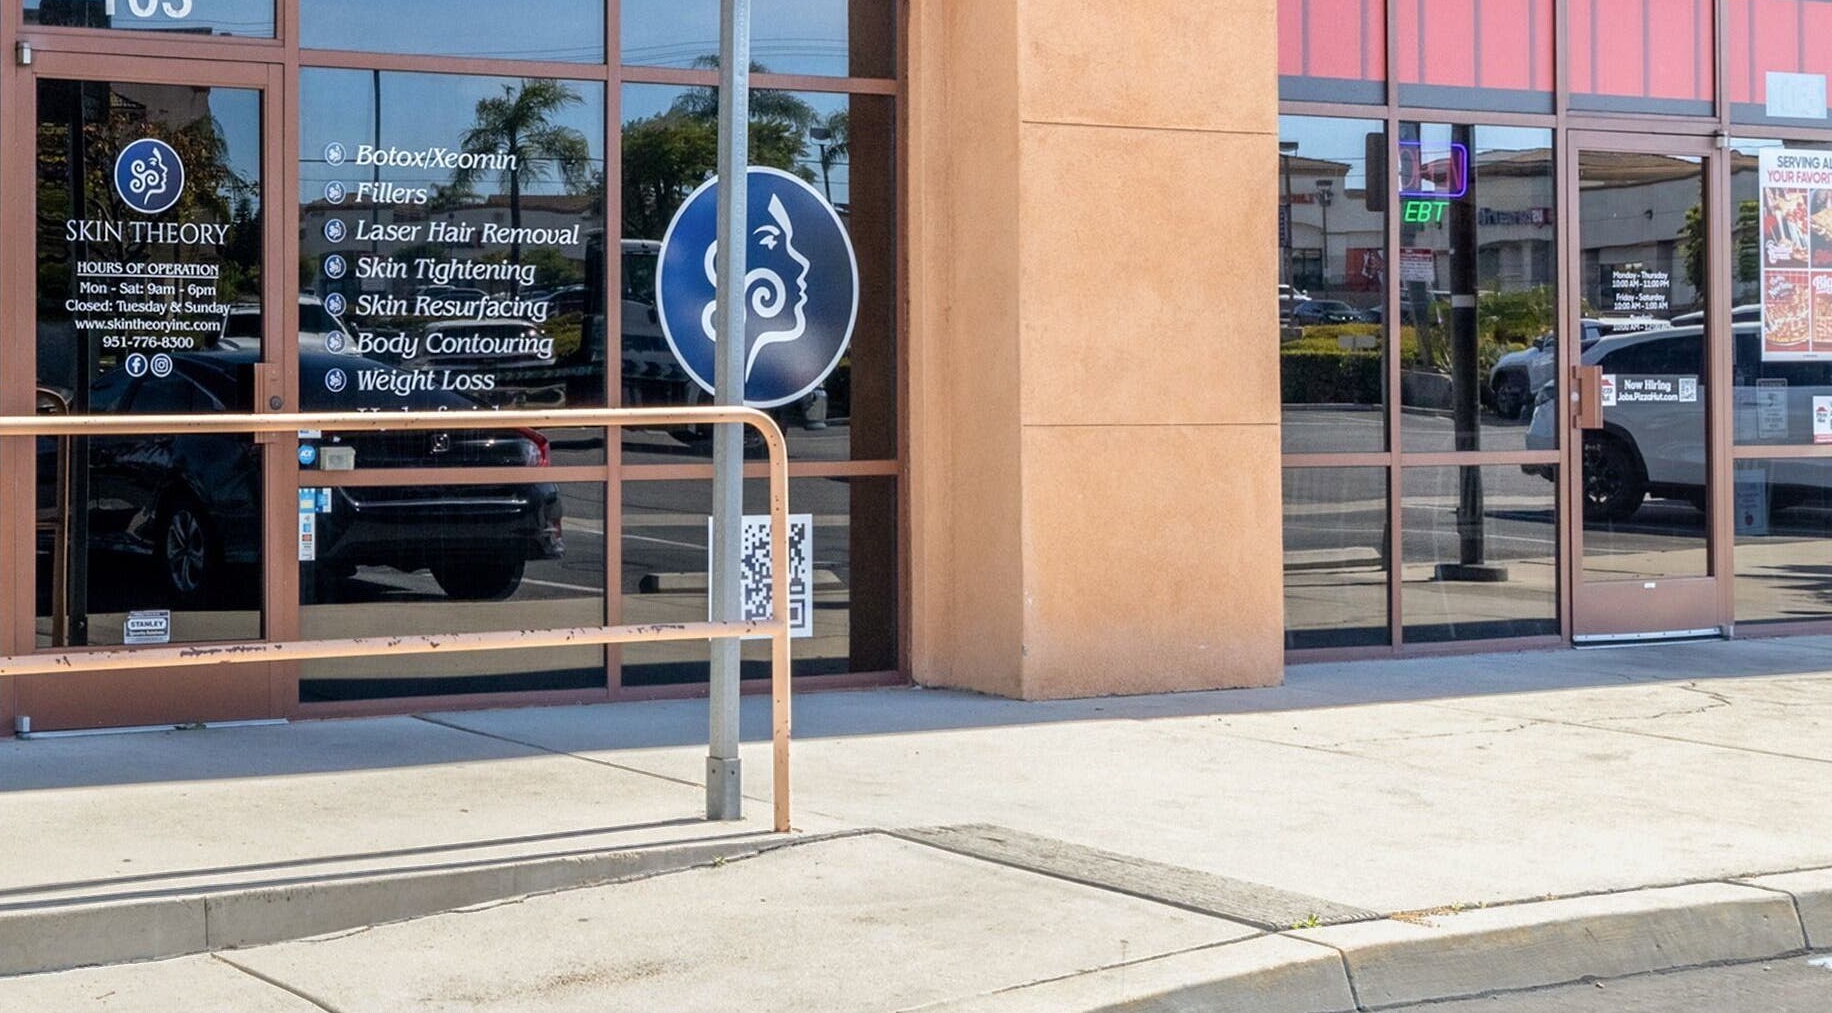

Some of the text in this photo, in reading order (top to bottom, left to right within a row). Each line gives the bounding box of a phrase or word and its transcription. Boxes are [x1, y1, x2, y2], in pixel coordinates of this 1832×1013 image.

[355, 145, 518, 171] Botox/Xeomin
[1777, 155, 1820, 168] SERVING
[1768, 170, 1794, 183] YOUR
[355, 182, 428, 205] Fillers
[1404, 201, 1450, 223] EBT
[66, 219, 230, 245] SKIN THEORY
[355, 220, 580, 245] Laser Hair Removal
[77, 261, 219, 276] HOURS OF OPERATION
[356, 258, 536, 286] Skin Tightening
[1612, 271, 1637, 281] Monday
[1641, 271, 1668, 281] Thursday
[80, 282, 108, 294] Mon
[119, 282, 144, 295] Sat:
[147, 283, 175, 295] 9am
[187, 284, 216, 298] 6pm
[1616, 293, 1635, 303] Friday
[1639, 293, 1665, 303] Saturday
[65, 299, 231, 316] Closed: Tuesday & Sunday
[356, 294, 548, 322] Skin Resurfacing
[74, 318, 221, 333] www.skintheoryinc.com
[103, 336, 194, 348] 951-776-8300
[356, 333, 554, 359] Body Contouring
[357, 369, 495, 396] Weight Loss
[1624, 379, 1672, 393] Now Hiring
[130, 620, 164, 628] STANLEY
